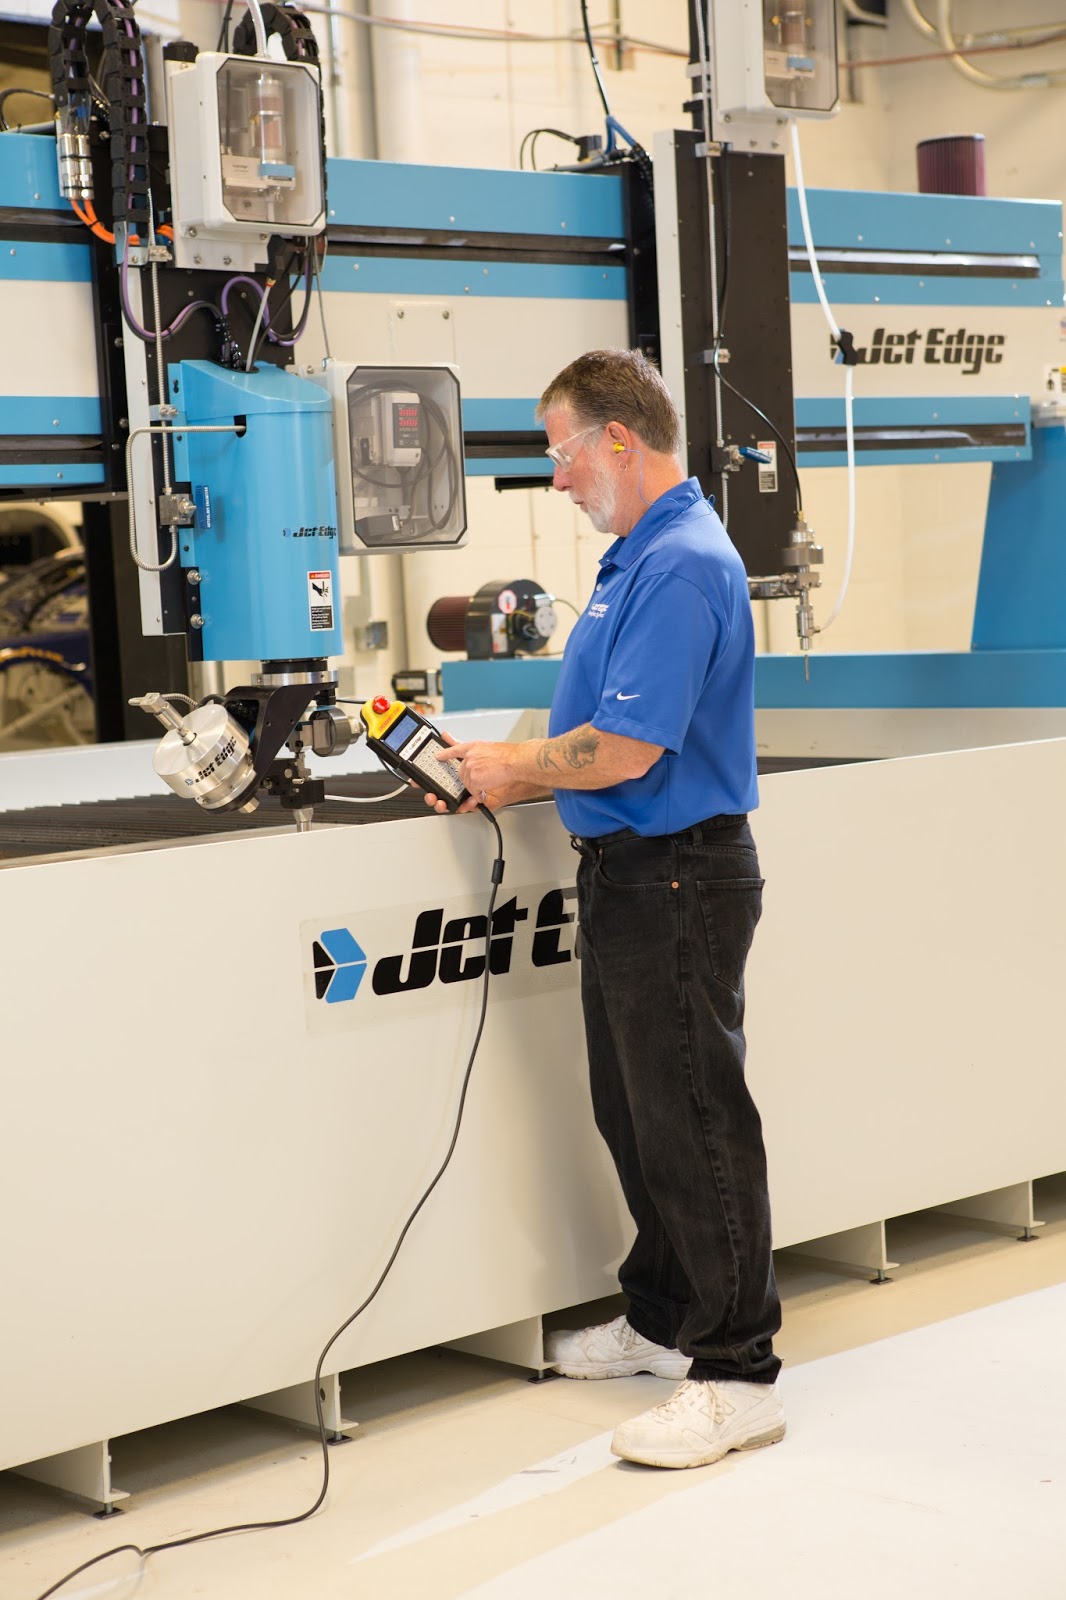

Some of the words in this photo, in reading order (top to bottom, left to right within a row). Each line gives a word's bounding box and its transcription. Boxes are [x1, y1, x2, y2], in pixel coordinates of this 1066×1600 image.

[856, 328, 922, 364] Jet
[924, 328, 1006, 375] Edge
[293, 527, 318, 537] Jet
[195, 762, 215, 783] Jet
[214, 735, 237, 766] Edge
[372, 896, 528, 996] Jet
